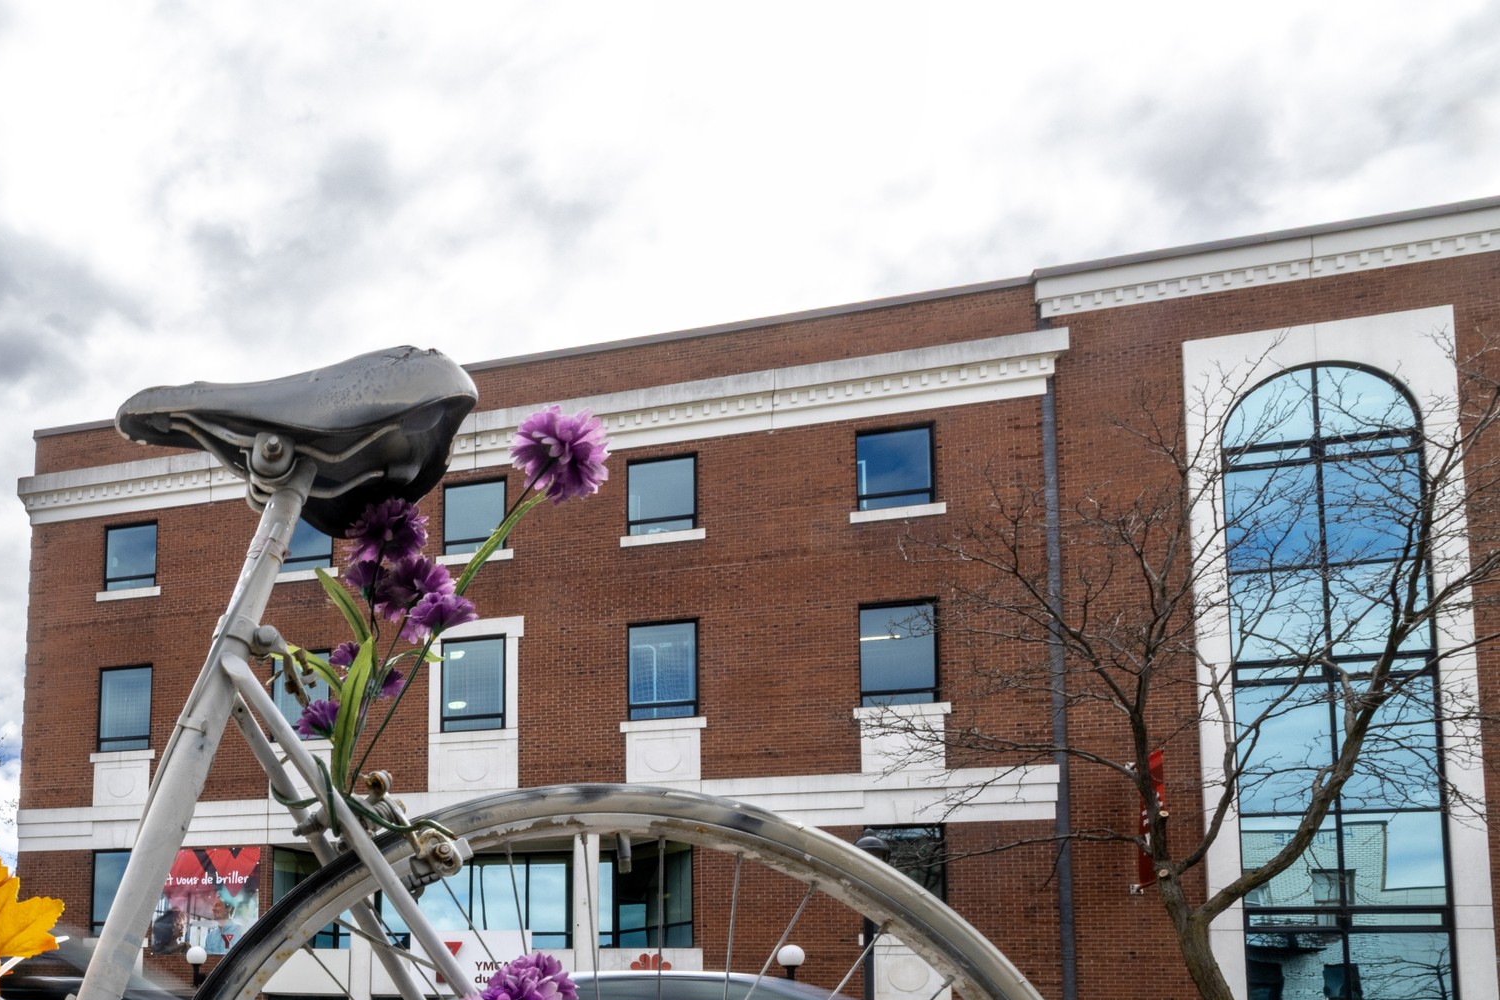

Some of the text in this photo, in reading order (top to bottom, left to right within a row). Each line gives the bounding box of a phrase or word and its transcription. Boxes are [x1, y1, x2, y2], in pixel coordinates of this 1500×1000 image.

[175, 876, 199, 885] vous
[201, 871, 213, 885] de
[215, 871, 250, 884] briller
[474, 974, 490, 984] du
